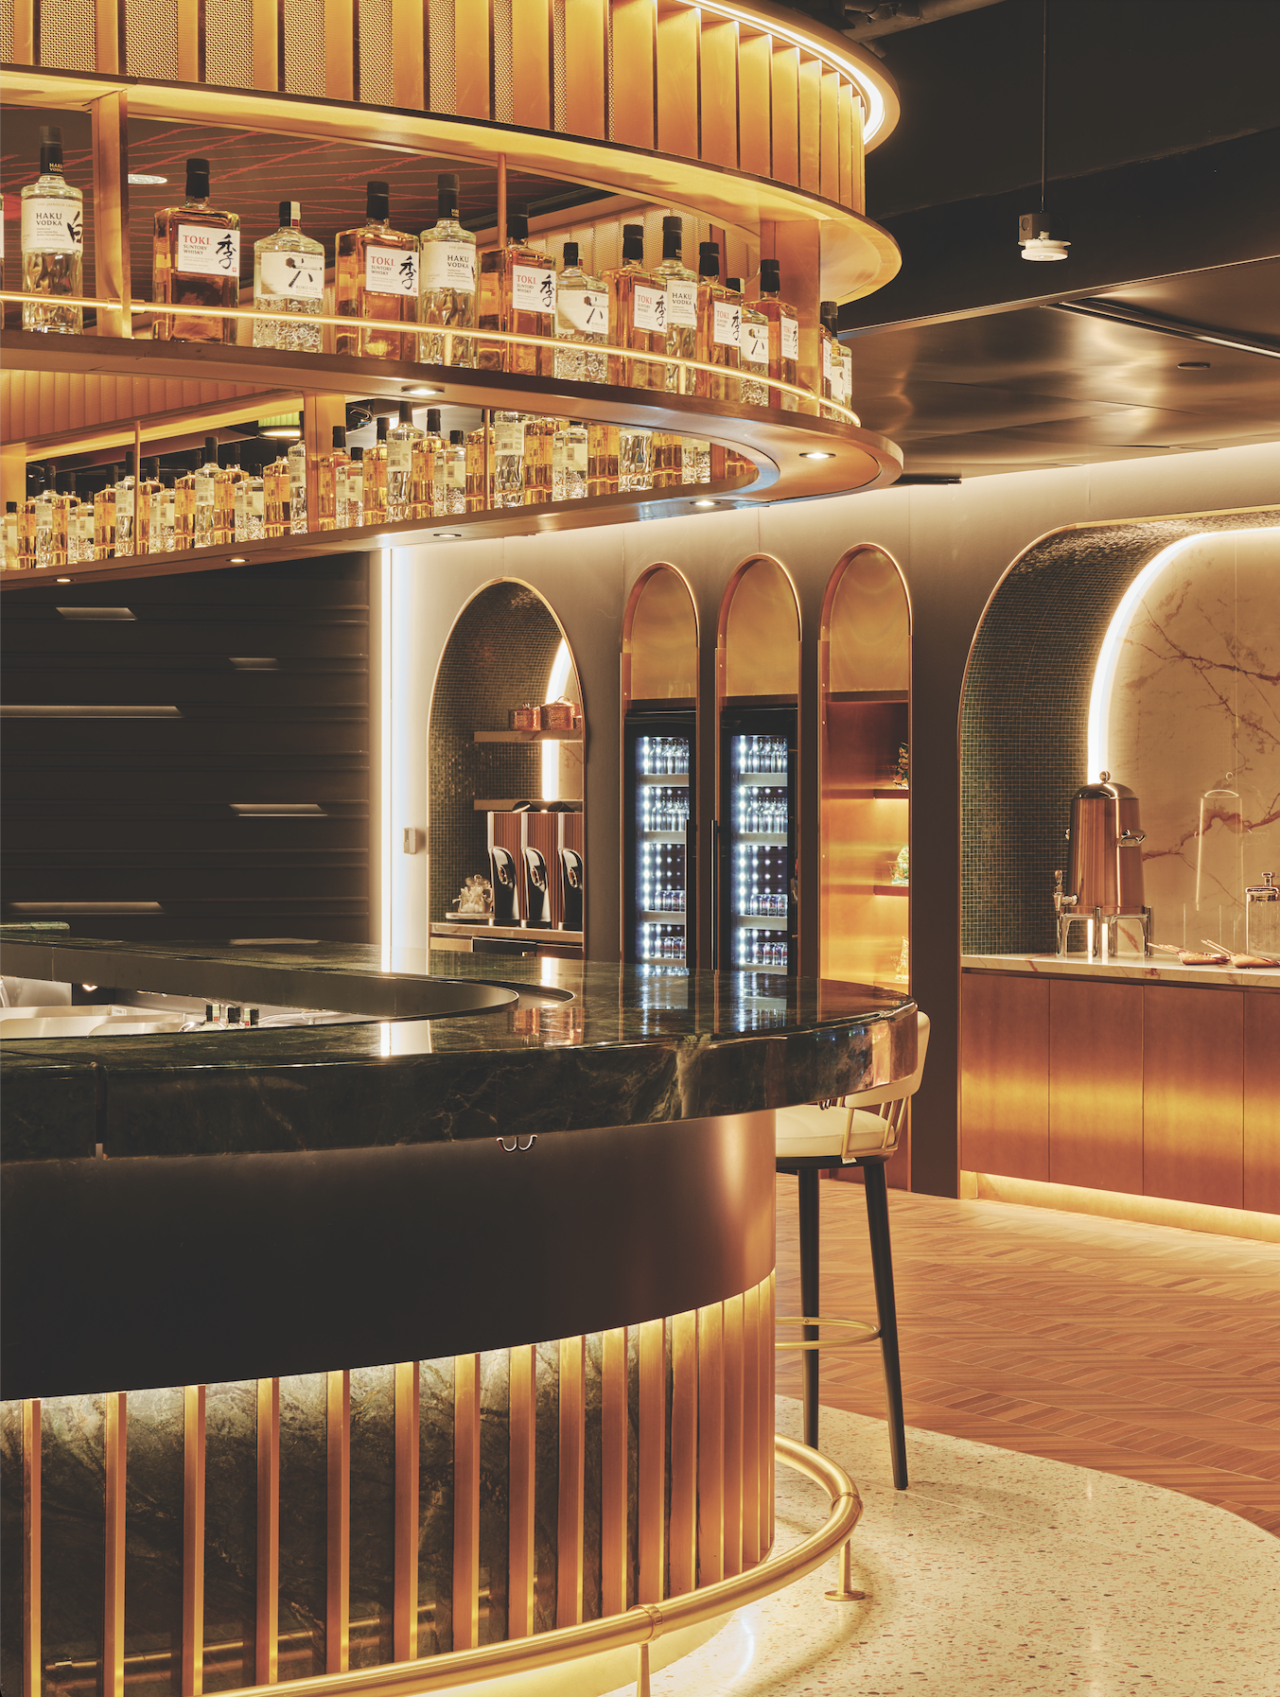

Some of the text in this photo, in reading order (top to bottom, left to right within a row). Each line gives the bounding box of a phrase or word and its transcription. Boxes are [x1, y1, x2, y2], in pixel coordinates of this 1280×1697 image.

[36, 212, 62, 220] HAKU
[183, 234, 210, 246] TOKI
[370, 255, 395, 267] TOKI
[447, 255, 470, 263] HAKU
[516, 274, 537, 285] TOKI
[637, 294, 653, 305] TOKI
[672, 292, 693, 300] HAKU
